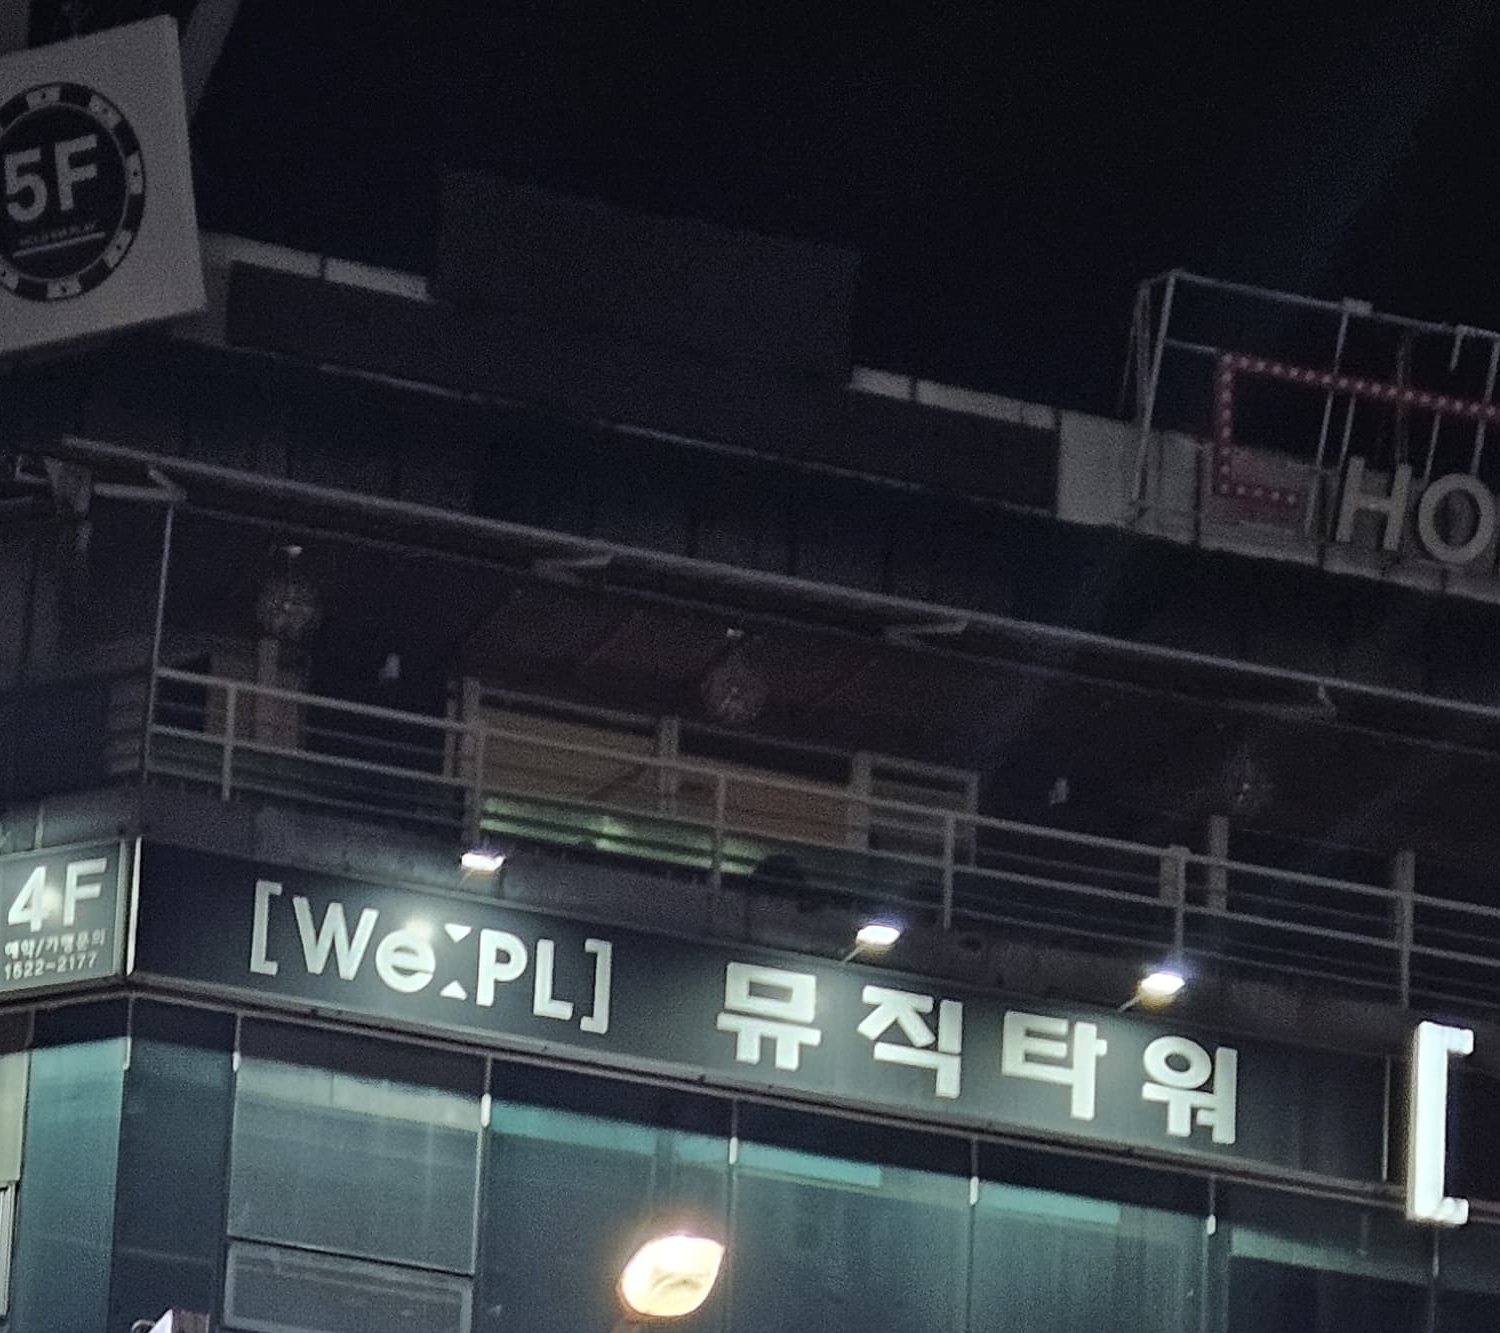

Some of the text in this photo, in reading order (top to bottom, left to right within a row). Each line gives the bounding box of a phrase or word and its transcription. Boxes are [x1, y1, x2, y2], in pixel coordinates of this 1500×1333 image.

[4, 133, 98, 222] 5F
[1336, 457, 1500, 564] HO
[7, 857, 108, 933] 4F
[716, 960, 1239, 1145] 뮤직타워
